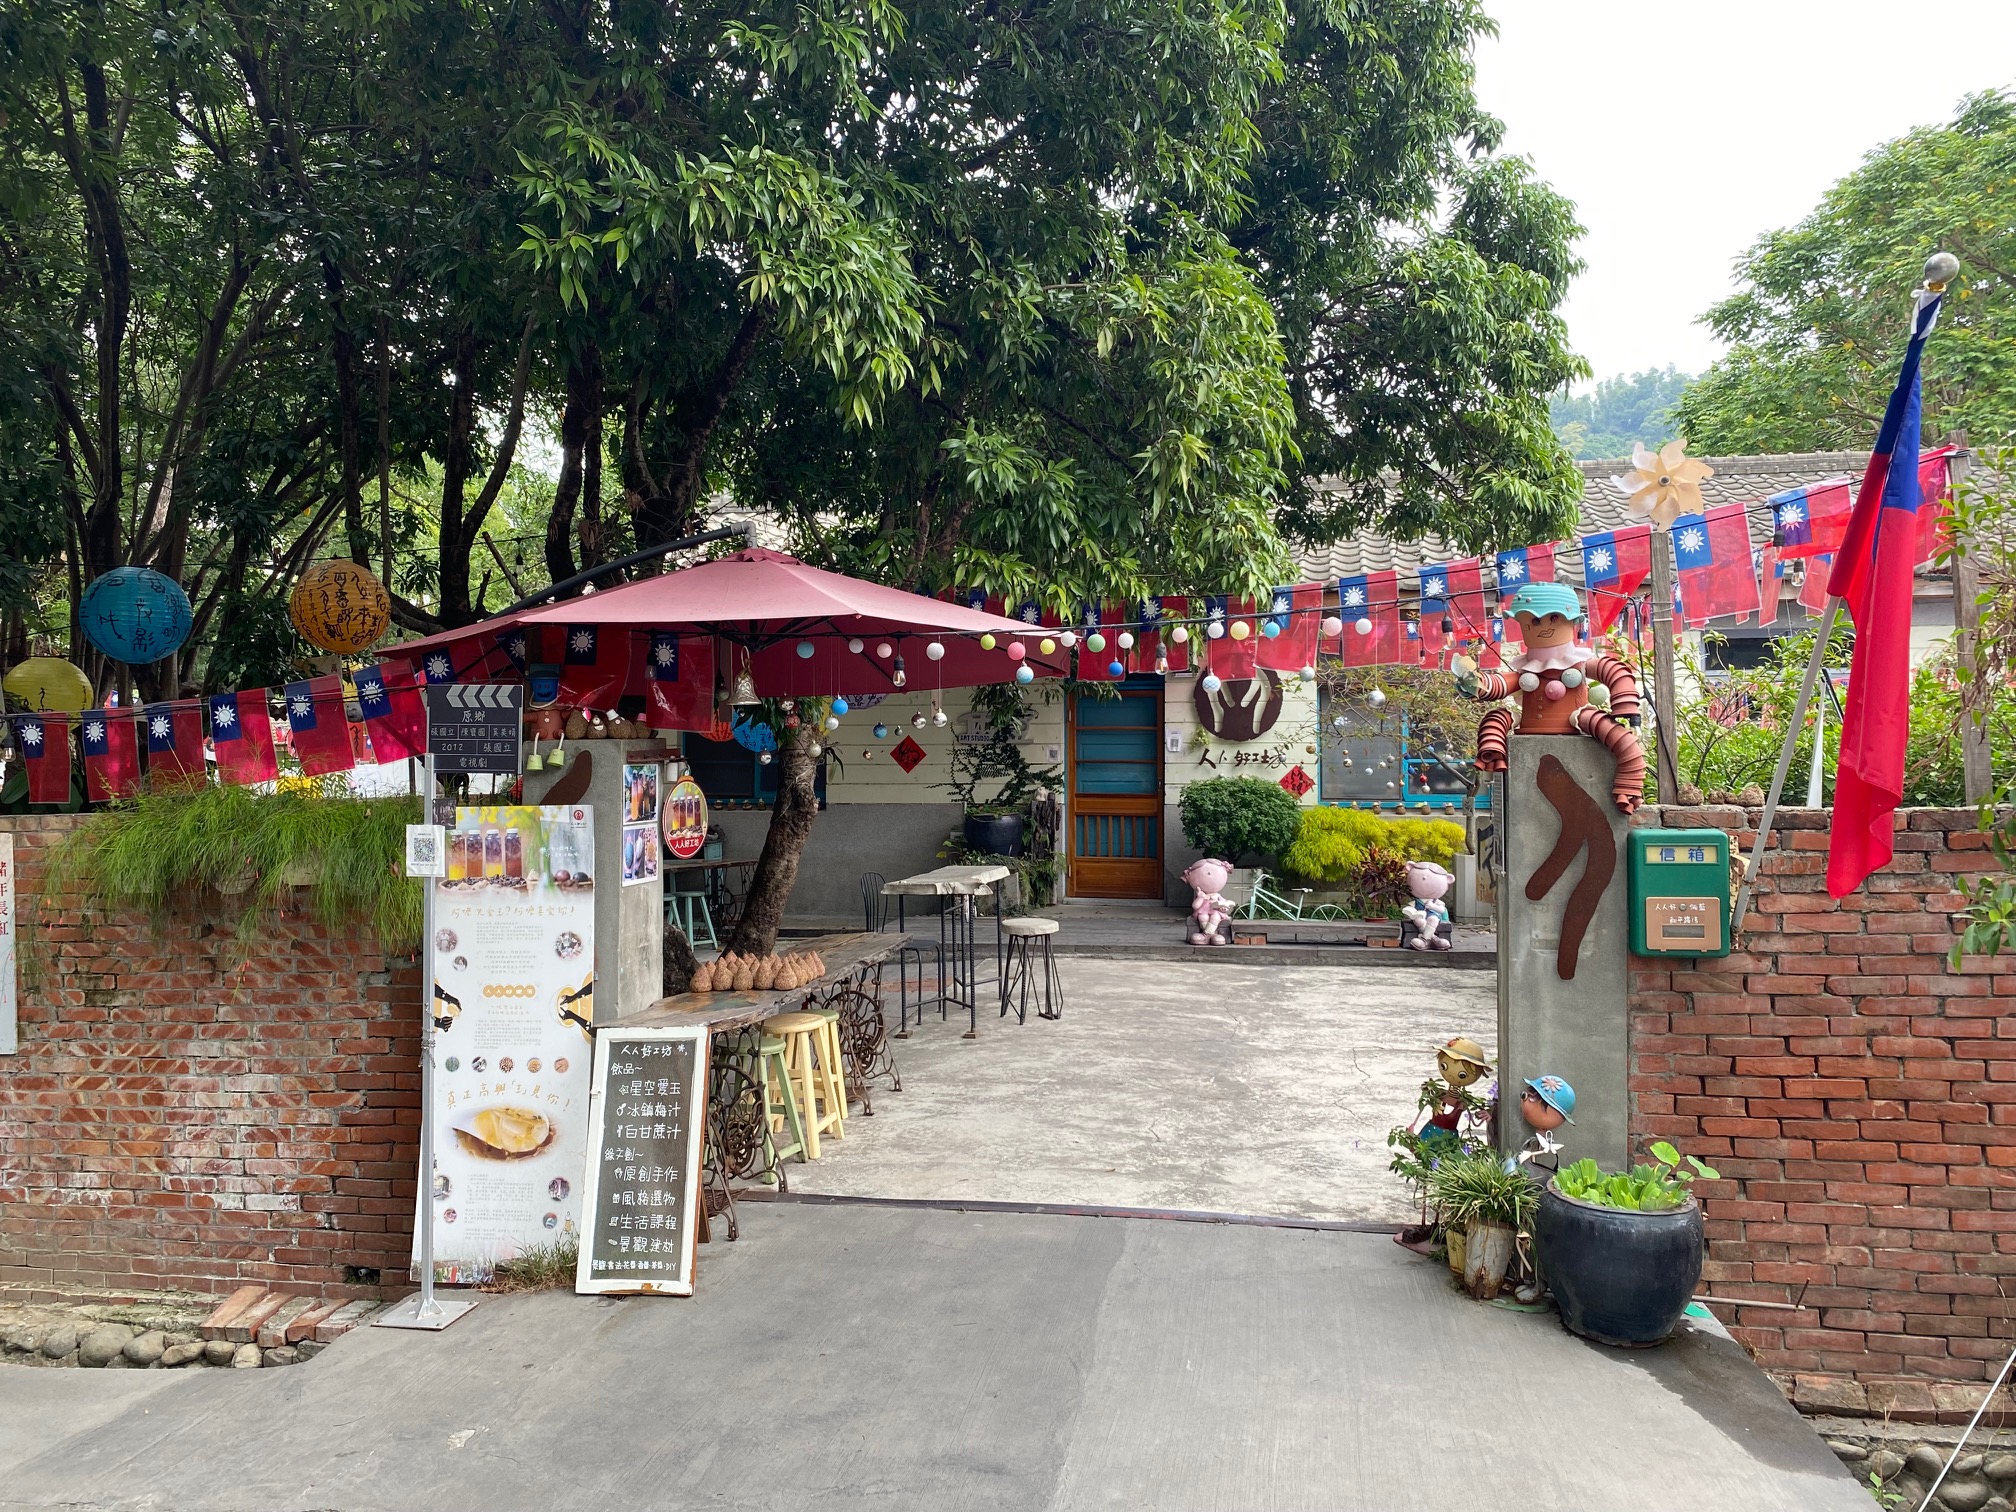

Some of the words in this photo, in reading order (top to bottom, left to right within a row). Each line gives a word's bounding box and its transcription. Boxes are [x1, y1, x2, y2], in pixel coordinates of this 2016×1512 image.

[461, 709, 486, 723] 原鄉
[441, 743, 464, 751] 2012
[483, 742, 512, 753] 張國立
[460, 757, 488, 768] 電視劇
[1659, 847, 1705, 863] 信箱
[620, 1044, 673, 1059] 人人好工坊
[630, 1078, 681, 1097] 星空愛玉
[626, 1101, 682, 1118] 冰鎮梅汁
[624, 1122, 682, 1140] 白甘蔗汁
[623, 1165, 679, 1183] 原創手作
[620, 1213, 677, 1231] 生活課程
